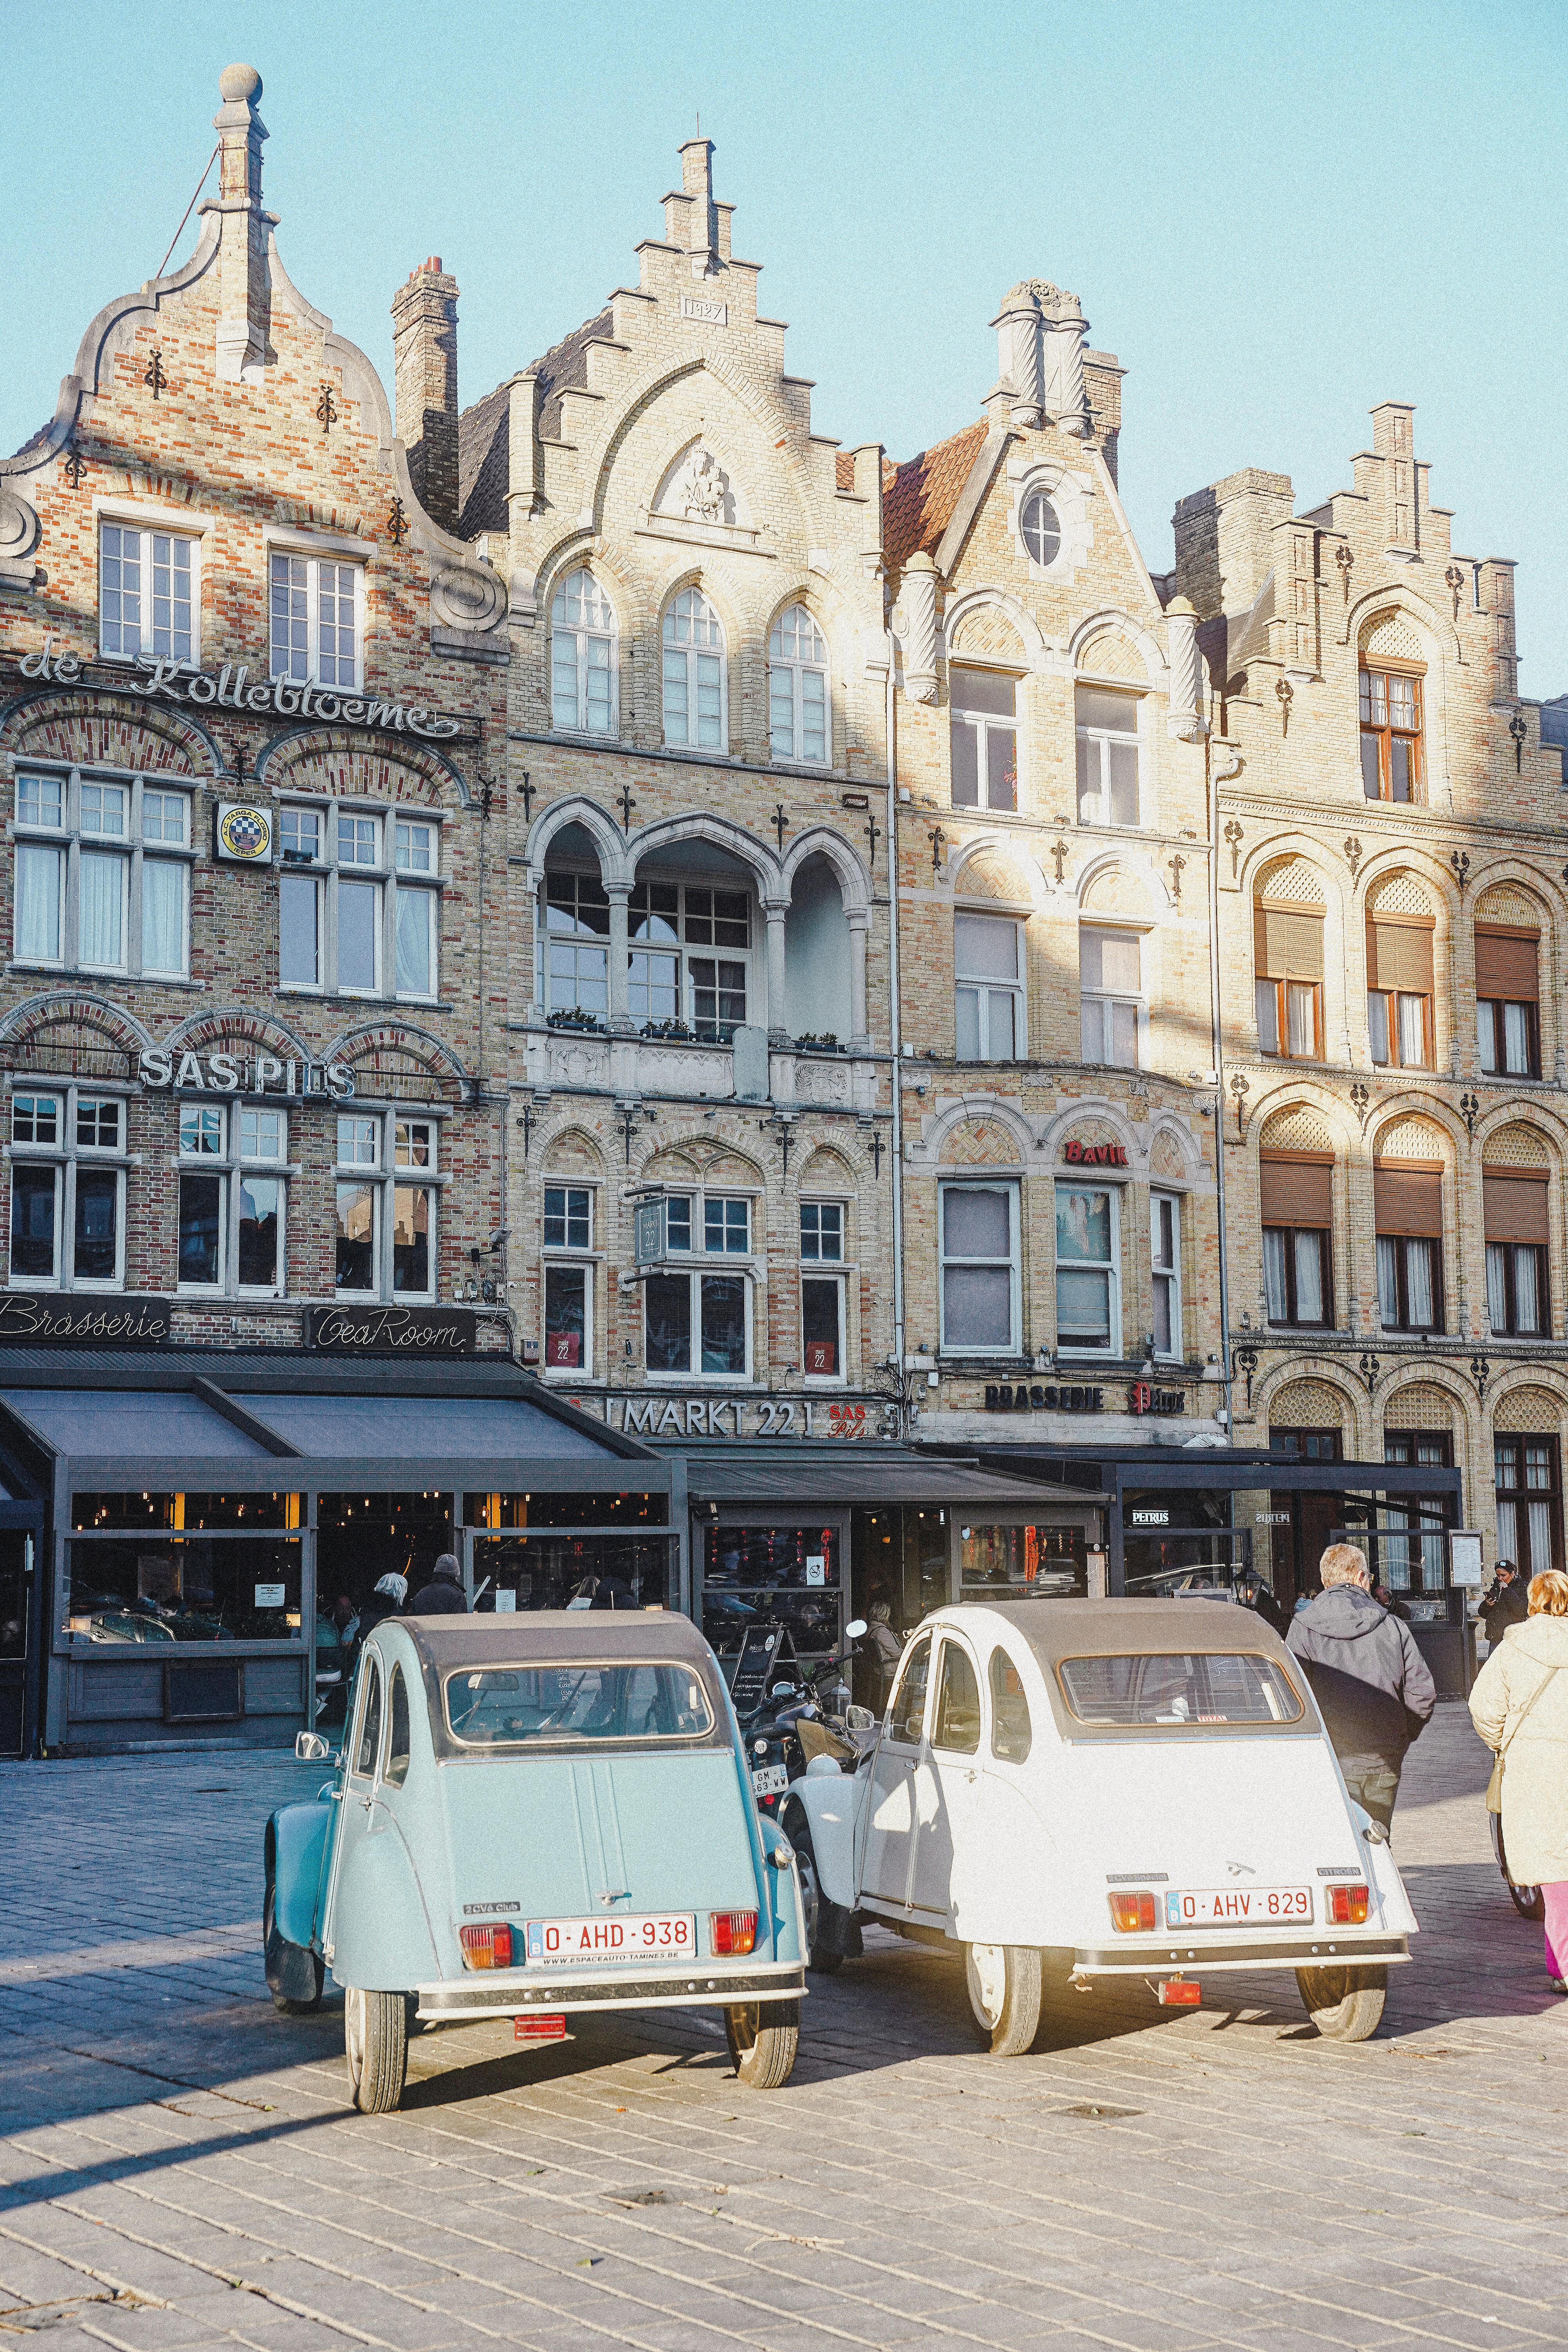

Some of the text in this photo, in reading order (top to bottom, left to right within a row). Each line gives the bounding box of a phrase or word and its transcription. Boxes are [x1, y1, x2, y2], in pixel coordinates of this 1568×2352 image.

[688, 299, 722, 319] 1927
[20, 635, 461, 738] de Kollebloeme
[227, 810, 252, 821] TARGA
[254, 815, 267, 841] FLORIO
[233, 848, 256, 856] IEPER
[140, 1048, 356, 1100] SAS PILS
[642, 1219, 658, 1230] MARKT
[645, 1230, 655, 1247] 22
[0, 1296, 167, 1337] Brasserie
[557, 1346, 569, 1359] 22
[815, 1354, 825, 1367] 22
[985, 1385, 1104, 1410] BRASSERIE
[830, 1405, 866, 1419] SAS
[828, 1420, 866, 1438] Pils
[1132, 1512, 1169, 1524] PETRUS
[495, 1902, 518, 1912] Club
